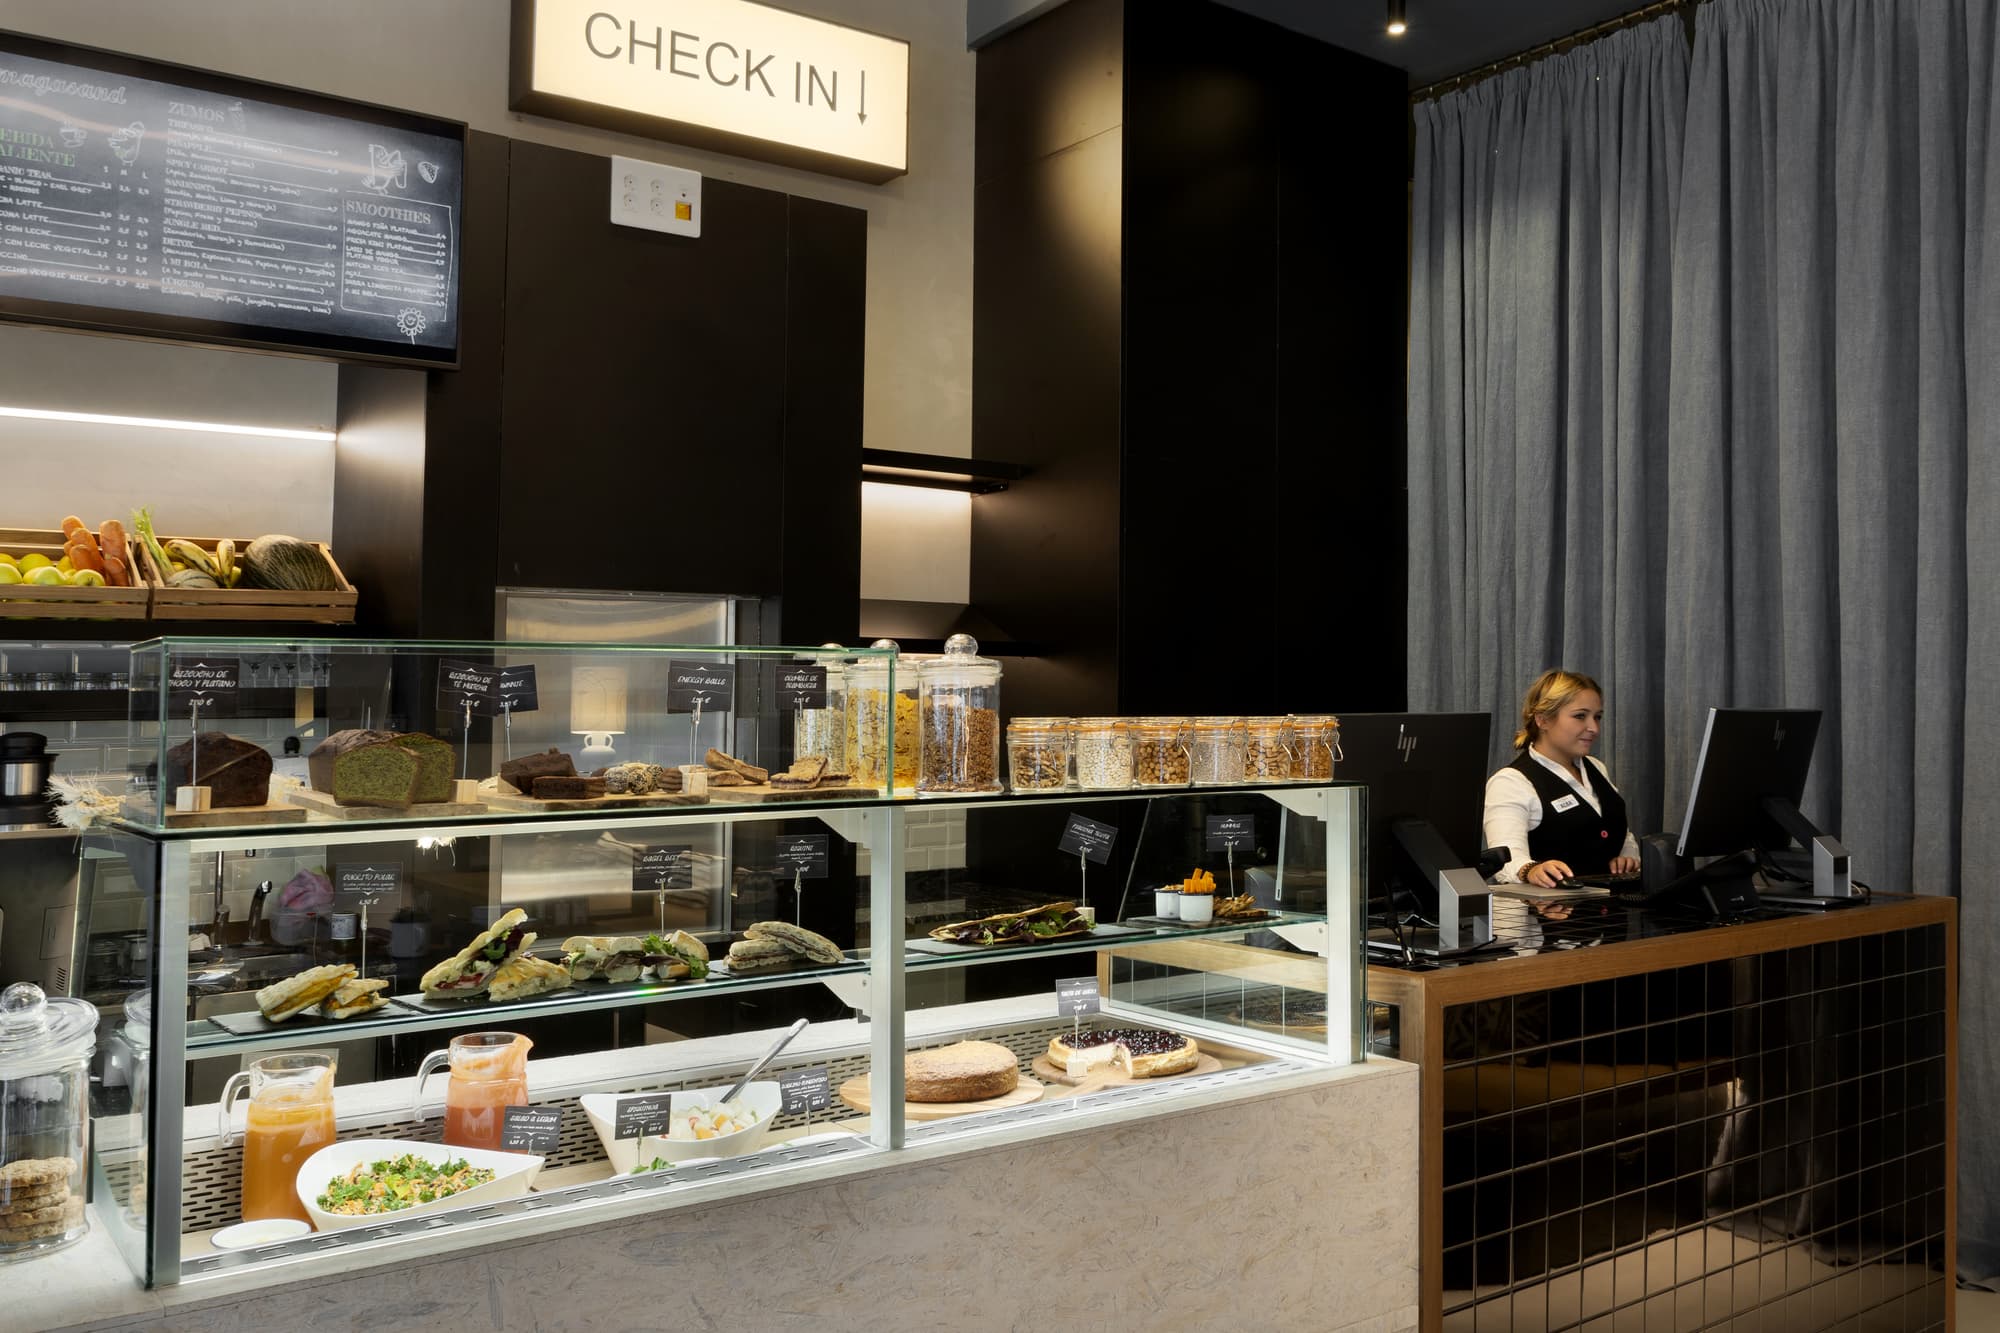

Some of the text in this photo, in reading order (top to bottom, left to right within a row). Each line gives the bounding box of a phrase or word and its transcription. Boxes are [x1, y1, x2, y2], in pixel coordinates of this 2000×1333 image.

[585, 12, 838, 112] CHECK IN
[168, 101, 225, 123] ZUMOS
[16, 198, 42, 207] LATTE
[22, 213, 48, 222] LATTE
[346, 202, 432, 224] SMOOTHIES
[54, 244, 90, 255] VEGETAL
[216, 670, 229, 678] DE
[169, 679, 193, 688] HOCO
[195, 680, 201, 688] Y
[677, 675, 705, 684] ENERGY
[206, 698, 214, 706] €
